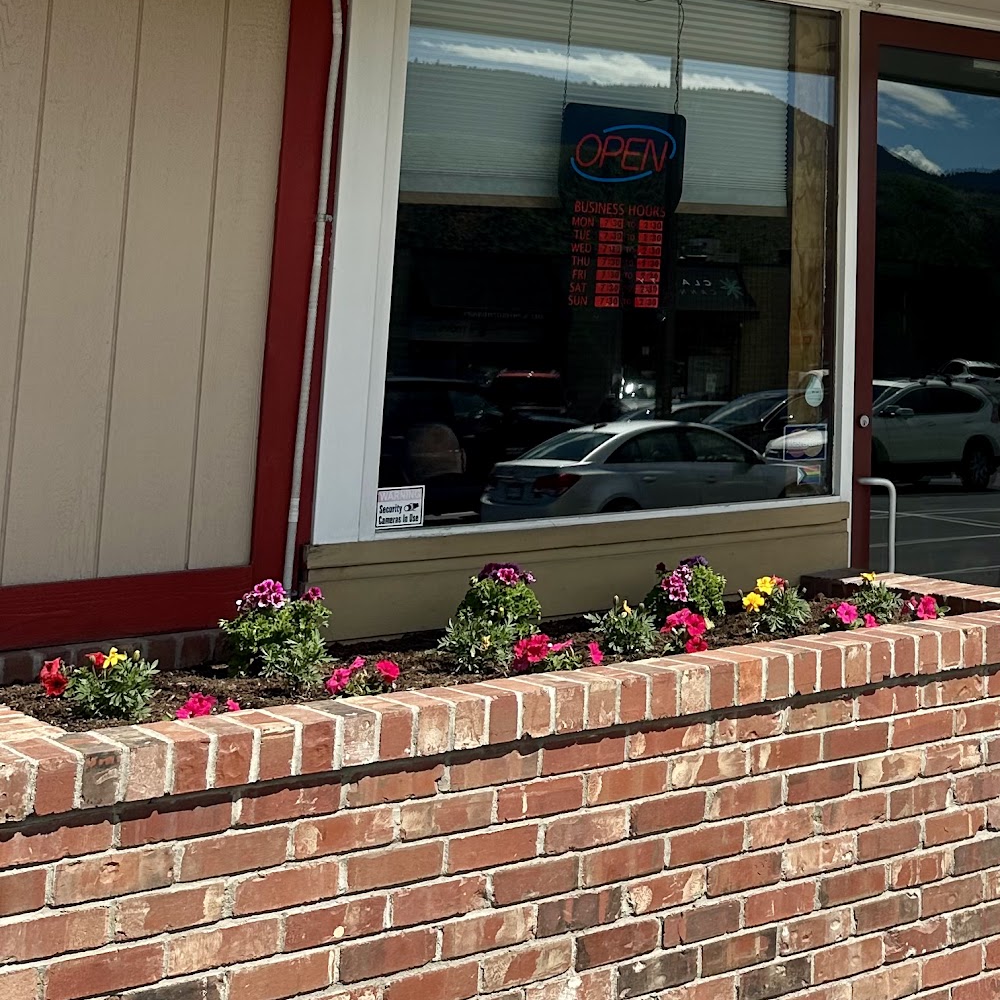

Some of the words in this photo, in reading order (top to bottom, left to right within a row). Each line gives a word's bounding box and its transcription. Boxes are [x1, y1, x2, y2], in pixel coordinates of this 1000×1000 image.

[575, 132, 669, 173] OPEN
[574, 200, 625, 215] BUSINESS
[628, 204, 666, 217] HOURS
[571, 216, 595, 228] MON
[573, 229, 591, 240] TUE
[570, 243, 592, 253] WED
[571, 255, 591, 266] THU
[571, 269, 587, 280] FRI
[569, 282, 588, 293] SAT
[568, 295, 588, 307] SUN
[378, 490, 421, 501] WARNING
[379, 504, 403, 514] Security
[378, 515, 401, 525] Cameras
